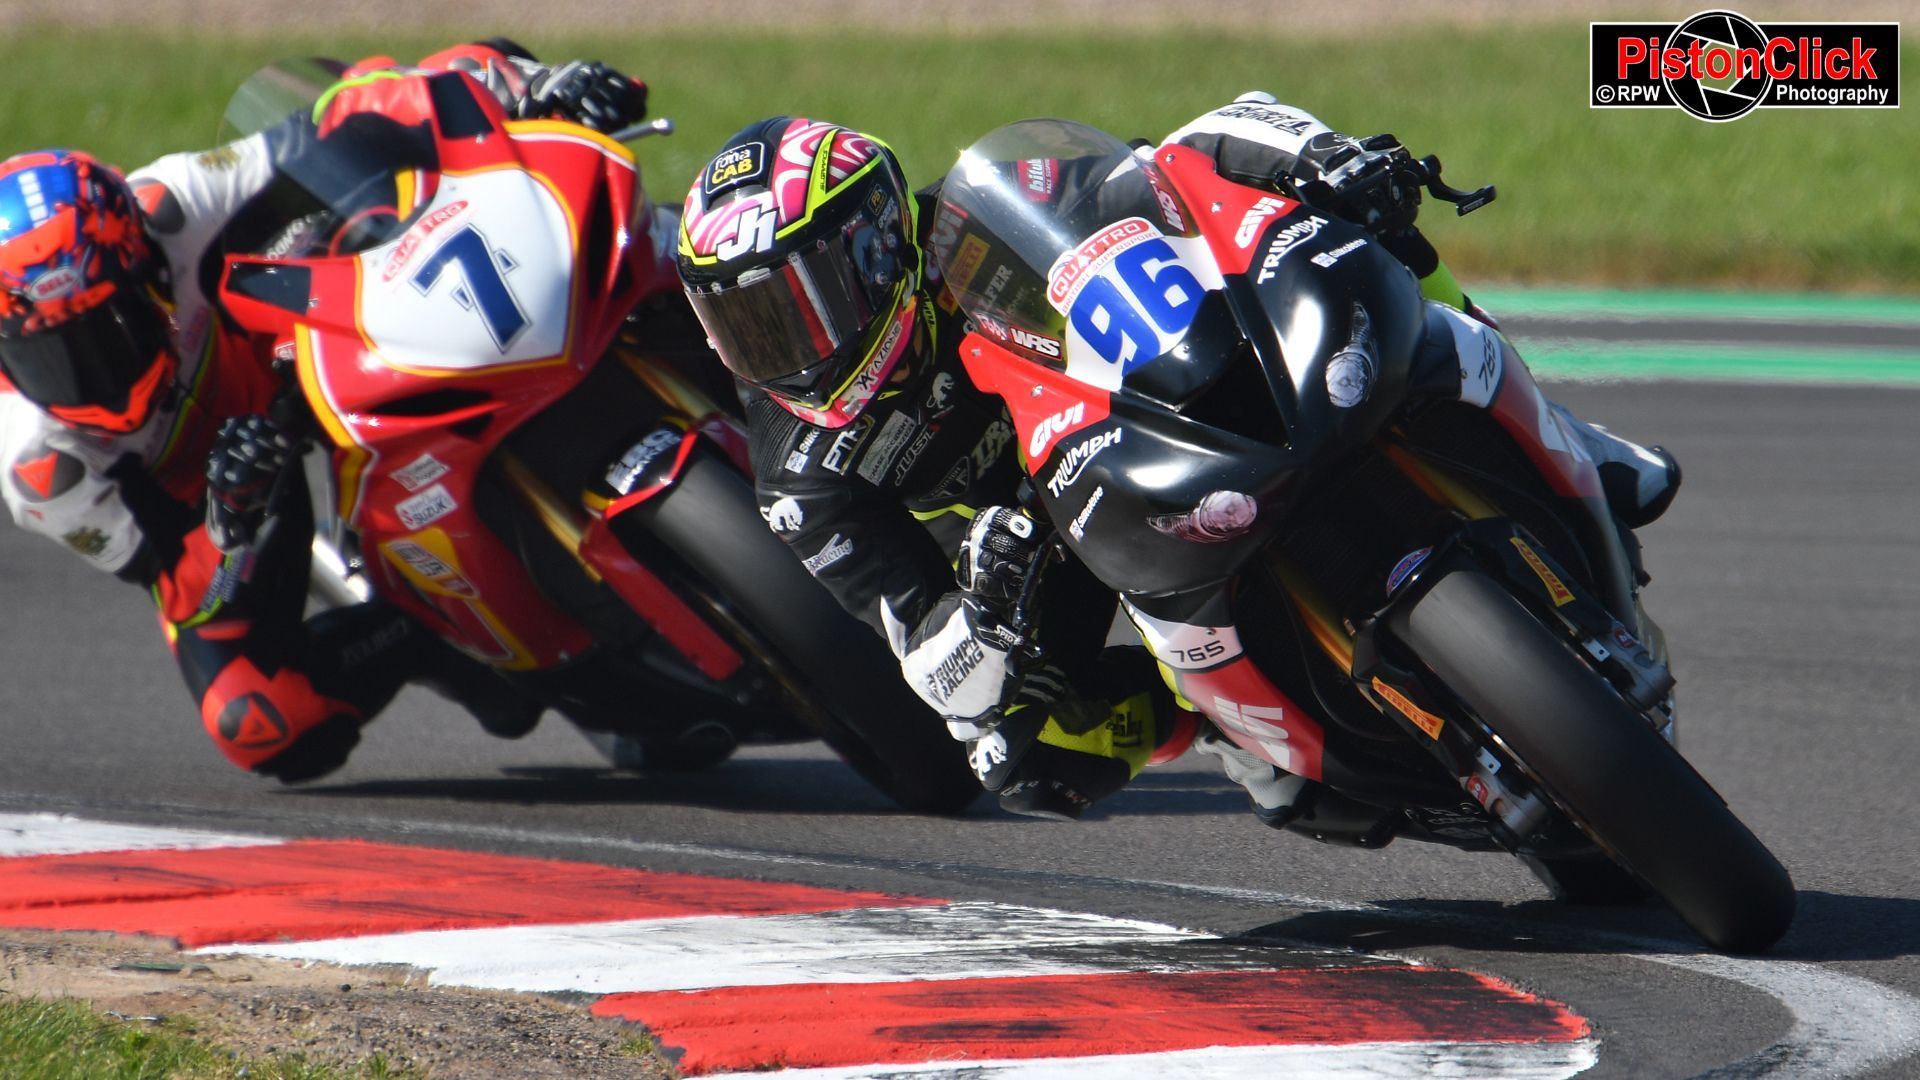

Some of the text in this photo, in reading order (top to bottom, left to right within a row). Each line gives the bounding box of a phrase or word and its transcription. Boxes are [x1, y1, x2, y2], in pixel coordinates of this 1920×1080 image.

[1235, 197, 1286, 249] GIVI
[1257, 215, 1329, 285] TRIUMPH
[409, 222, 534, 355] 7
[1053, 222, 1142, 298] QUATTRO
[1070, 238, 1206, 379] 96
[1011, 328, 1059, 357] WRS
[1030, 401, 1085, 458] GIVI
[1047, 427, 1122, 498] TRIUMPH
[940, 650, 985, 701] RACING
[1169, 640, 1226, 663] 765
